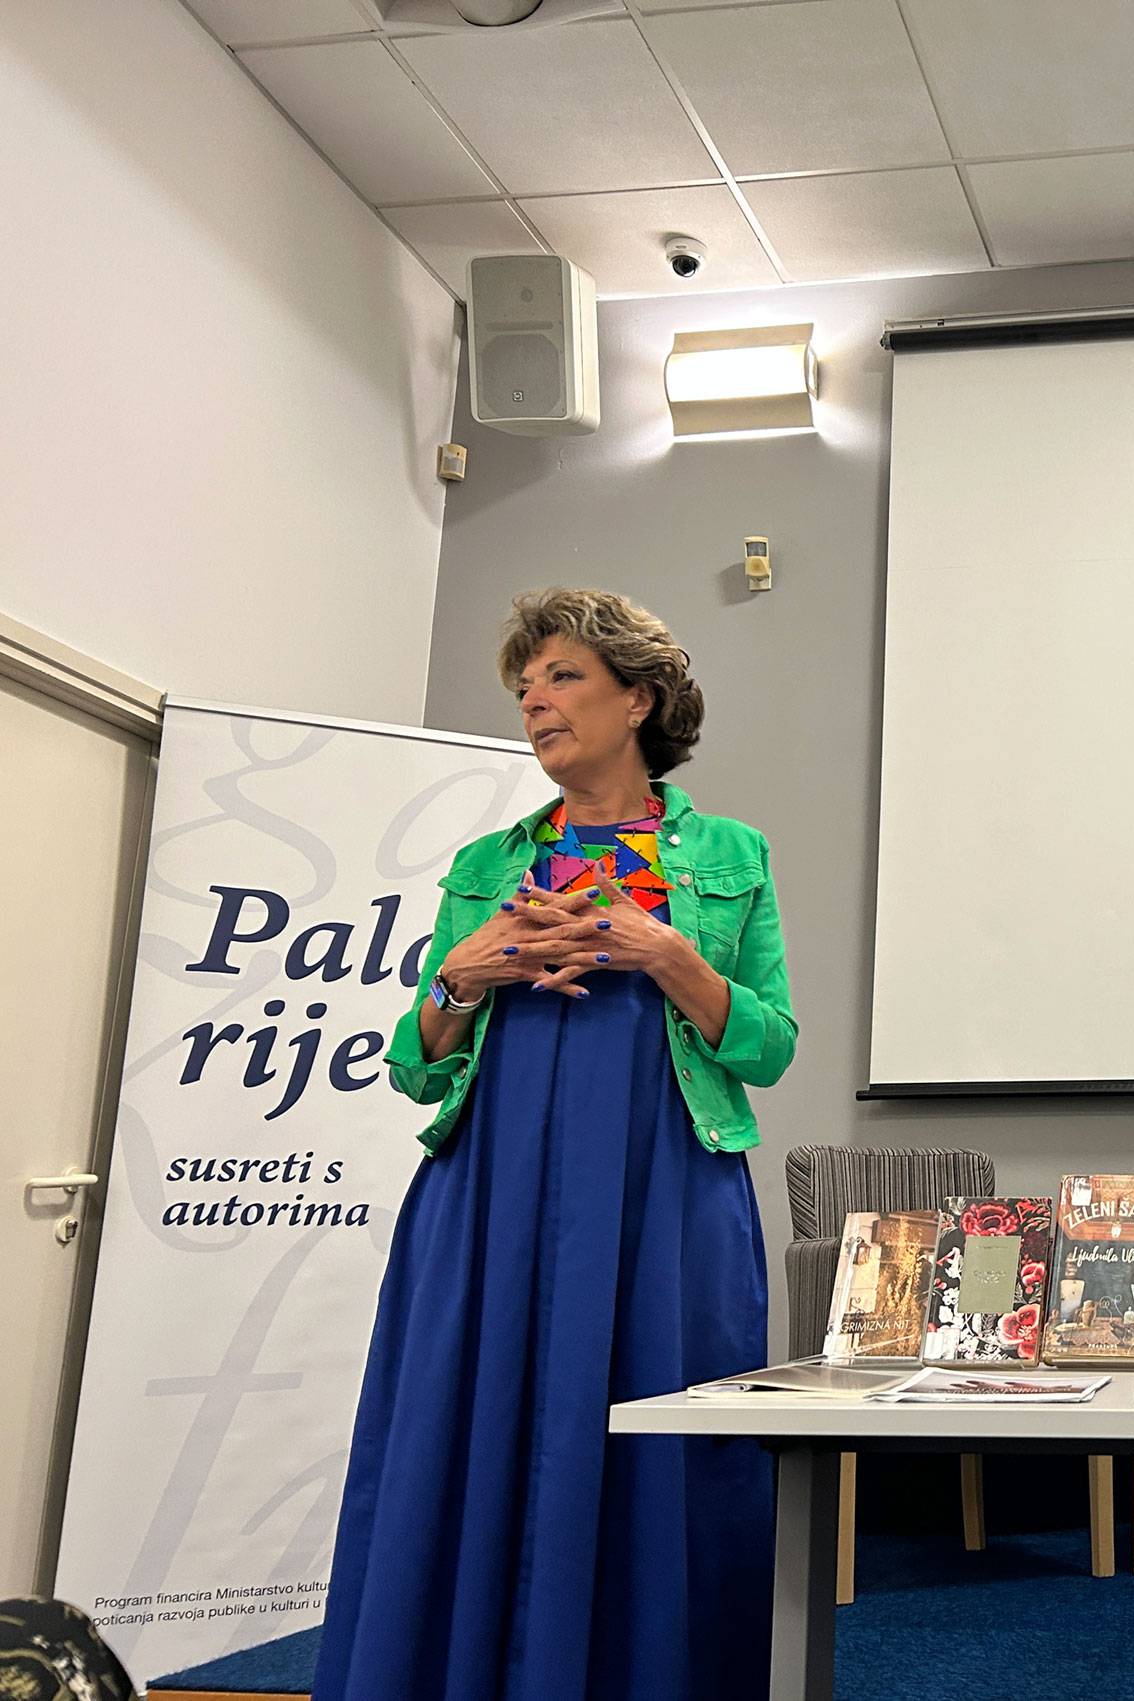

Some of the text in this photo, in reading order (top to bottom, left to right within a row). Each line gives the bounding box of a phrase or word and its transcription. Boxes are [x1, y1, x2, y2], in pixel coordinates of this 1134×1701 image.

[178, 999, 405, 1121] rije
[166, 1151, 344, 1185] susreti s
[161, 1194, 370, 1228] autorima
[1063, 1200, 1116, 1230] ZELENI
[1072, 1245, 1118, 1267] Ljudmila
[841, 1319, 909, 1332] GRIMIZNA NIT
[94, 1580, 328, 1610] Program financira Ministarstvo kultu
[92, 1599, 321, 1627] poticanja razvoja publike u kulturi u
